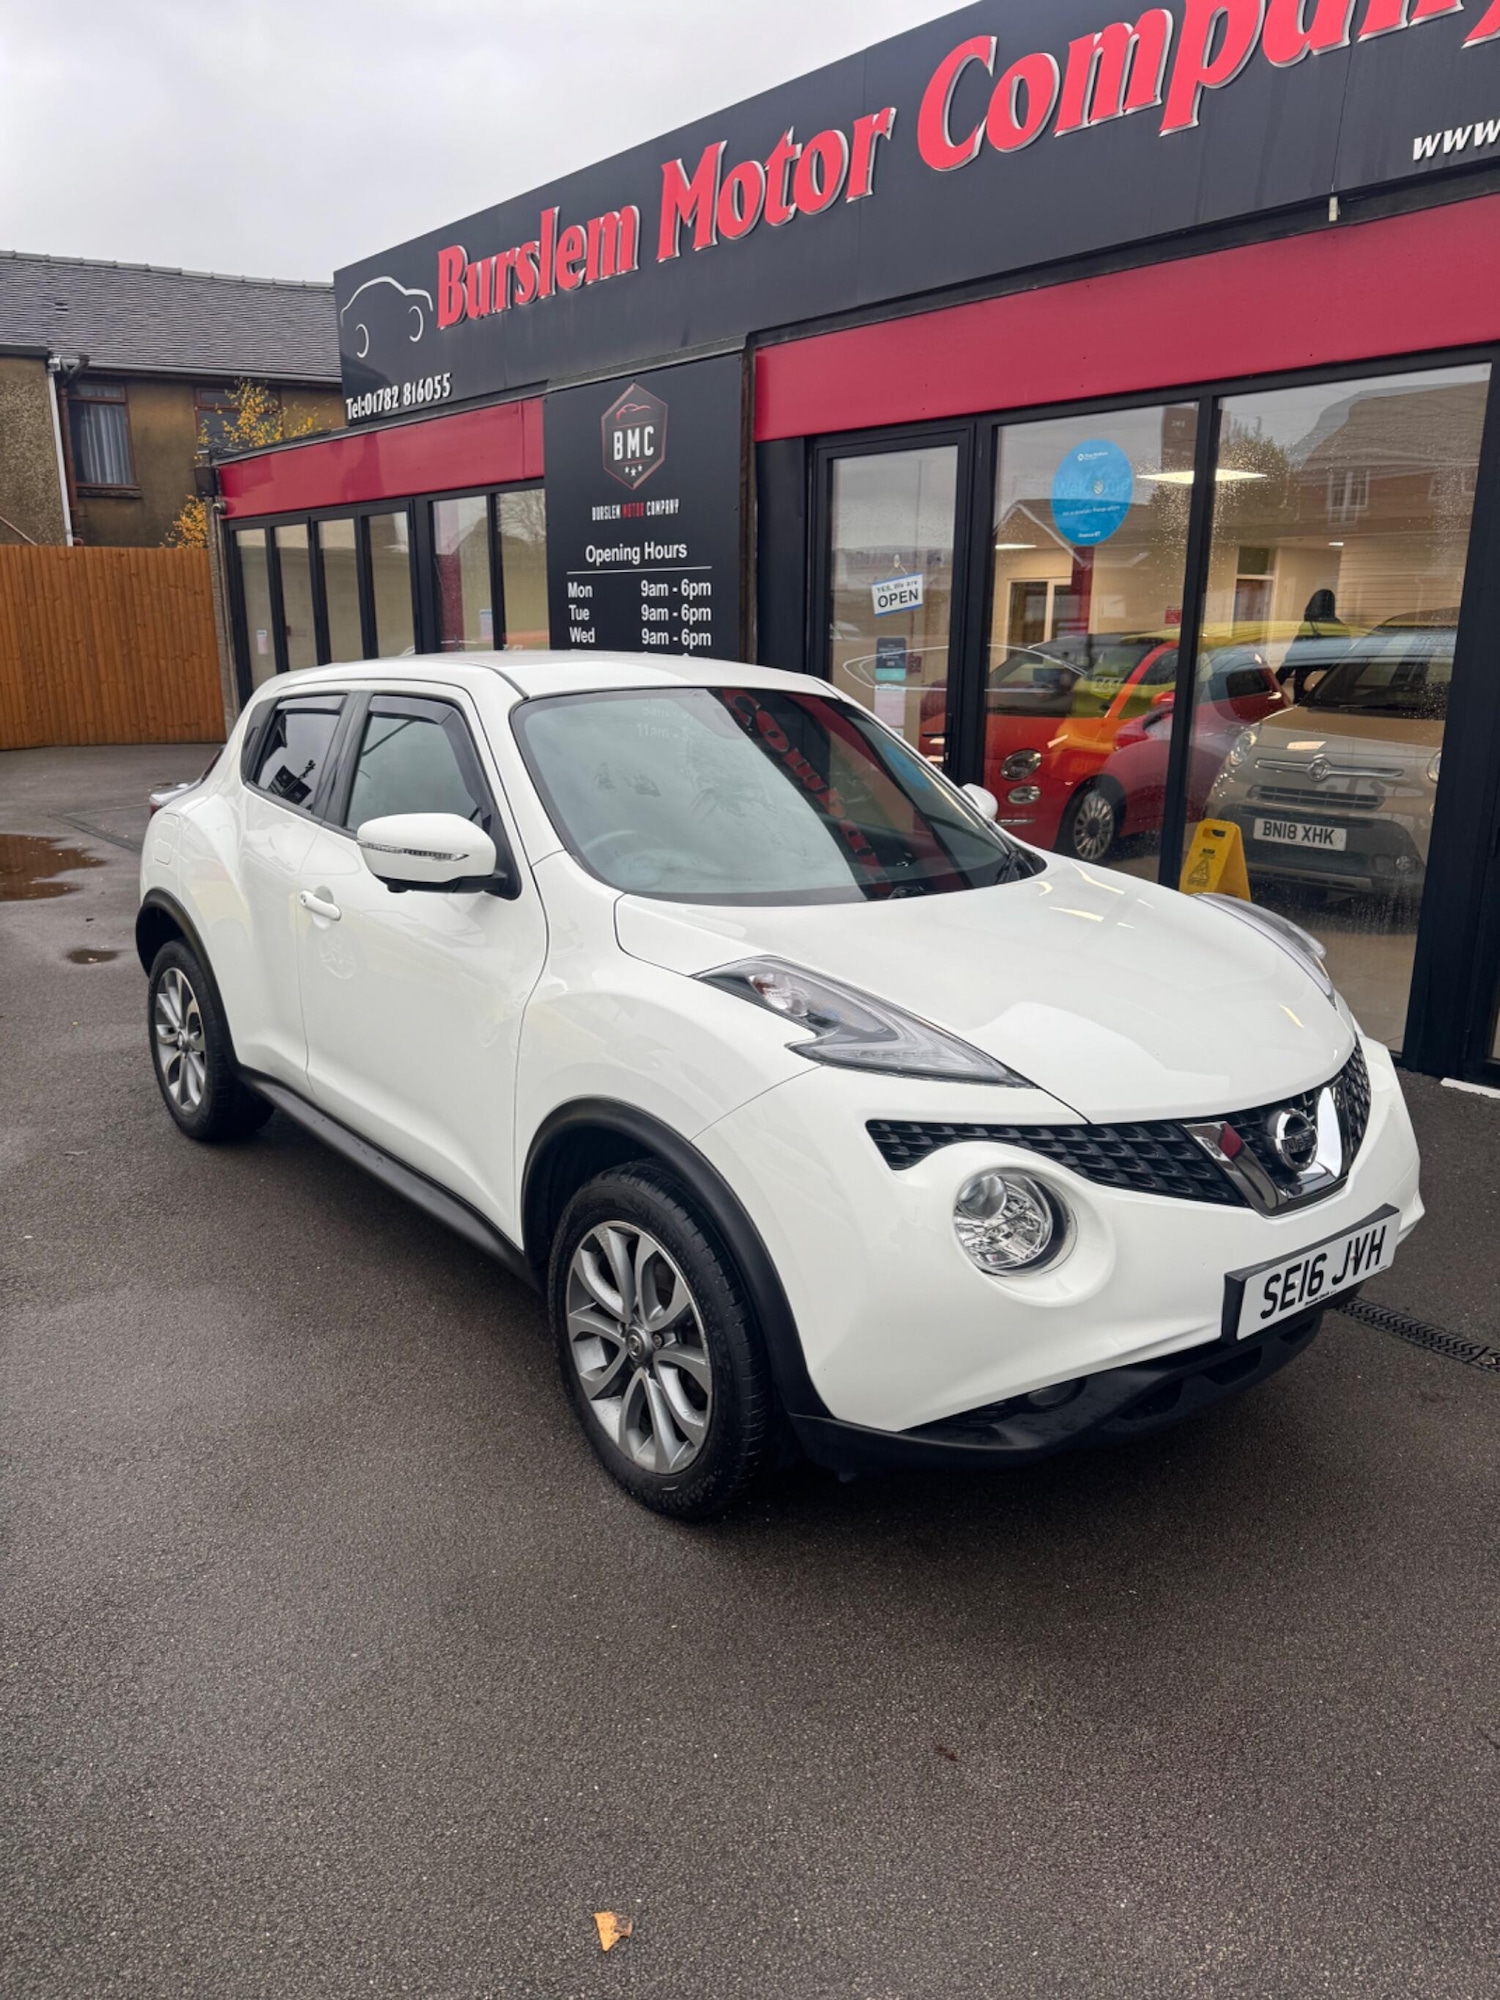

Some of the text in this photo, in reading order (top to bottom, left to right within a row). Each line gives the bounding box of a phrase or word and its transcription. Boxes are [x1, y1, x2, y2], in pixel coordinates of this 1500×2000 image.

[437, 206, 640, 330] Burslem
[656, 107, 897, 263] Motor
[346, 373, 451, 420] Tel:01782 816055
[613, 426, 655, 460] BMC
[585, 541, 688, 565] Opening Hours
[568, 582, 593, 598] Mon
[641, 580, 669, 597] 9am
[681, 579, 712, 600] 6pm
[878, 588, 919, 608] OPEN
[568, 604, 590, 621] Tue
[641, 604, 669, 621] 9am
[681, 604, 712, 625] 6pm
[570, 627, 595, 643] Wed
[641, 629, 669, 645] 9am
[681, 629, 712, 650] 6pm
[1262, 819, 1337, 846] BN18 XHK
[1260, 1225, 1387, 1320] SE16 JVH
